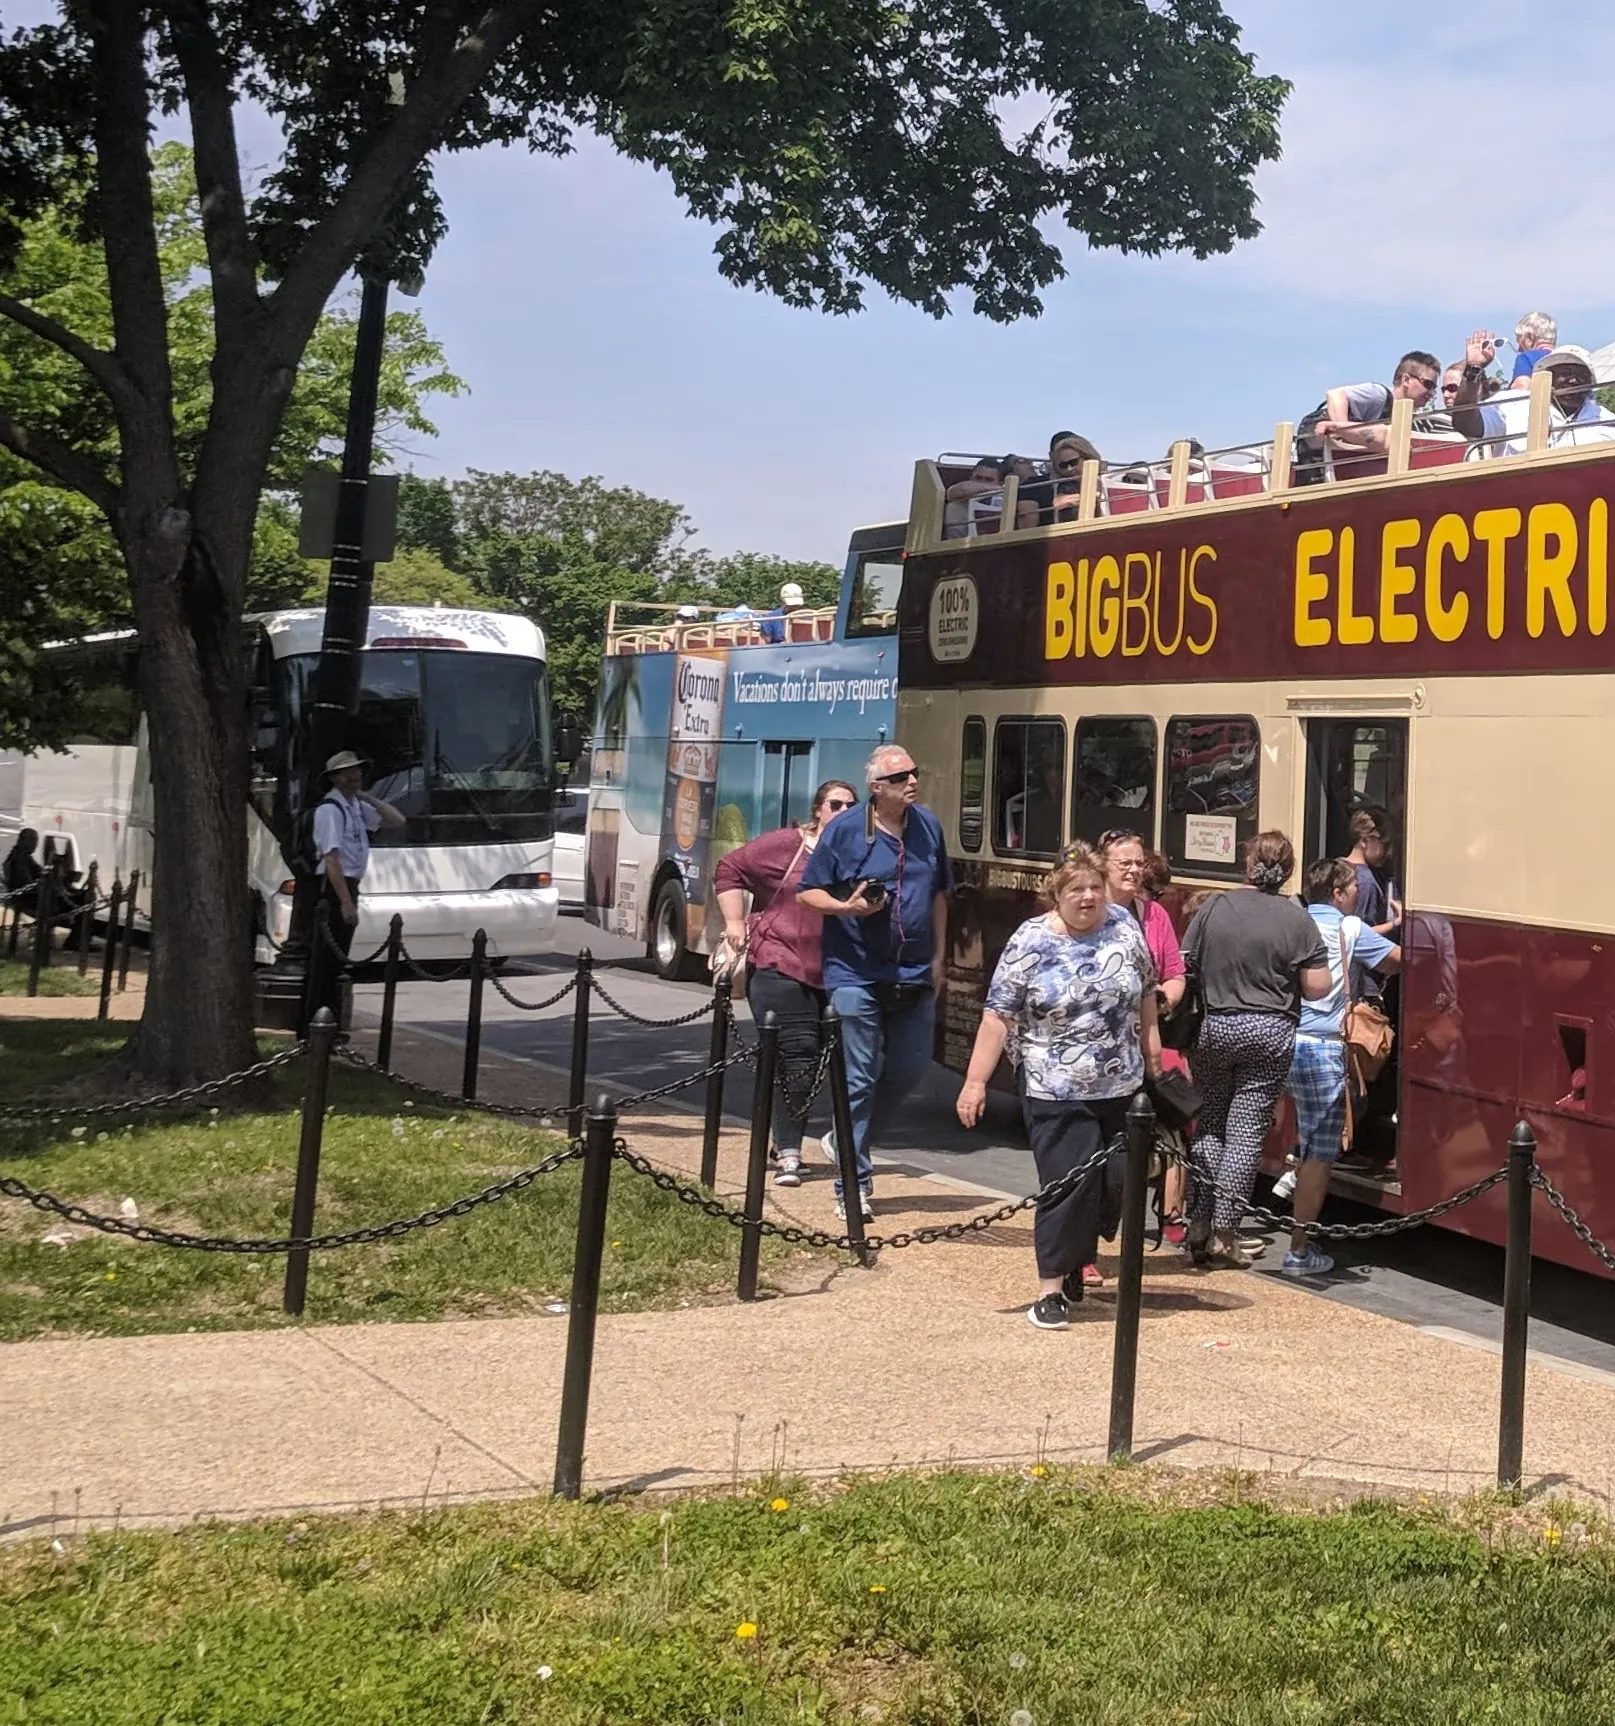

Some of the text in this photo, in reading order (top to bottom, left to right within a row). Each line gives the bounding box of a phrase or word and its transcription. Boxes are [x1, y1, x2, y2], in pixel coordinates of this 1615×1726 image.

[940, 586, 969, 615] 100%
[938, 616, 969, 634] ELECTRIC
[678, 660, 720, 704] Corona
[733, 671, 779, 704] Vacations
[780, 668, 807, 703] don't
[808, 668, 845, 715] always
[845, 669, 889, 715] require
[684, 703, 710, 735] Extra
